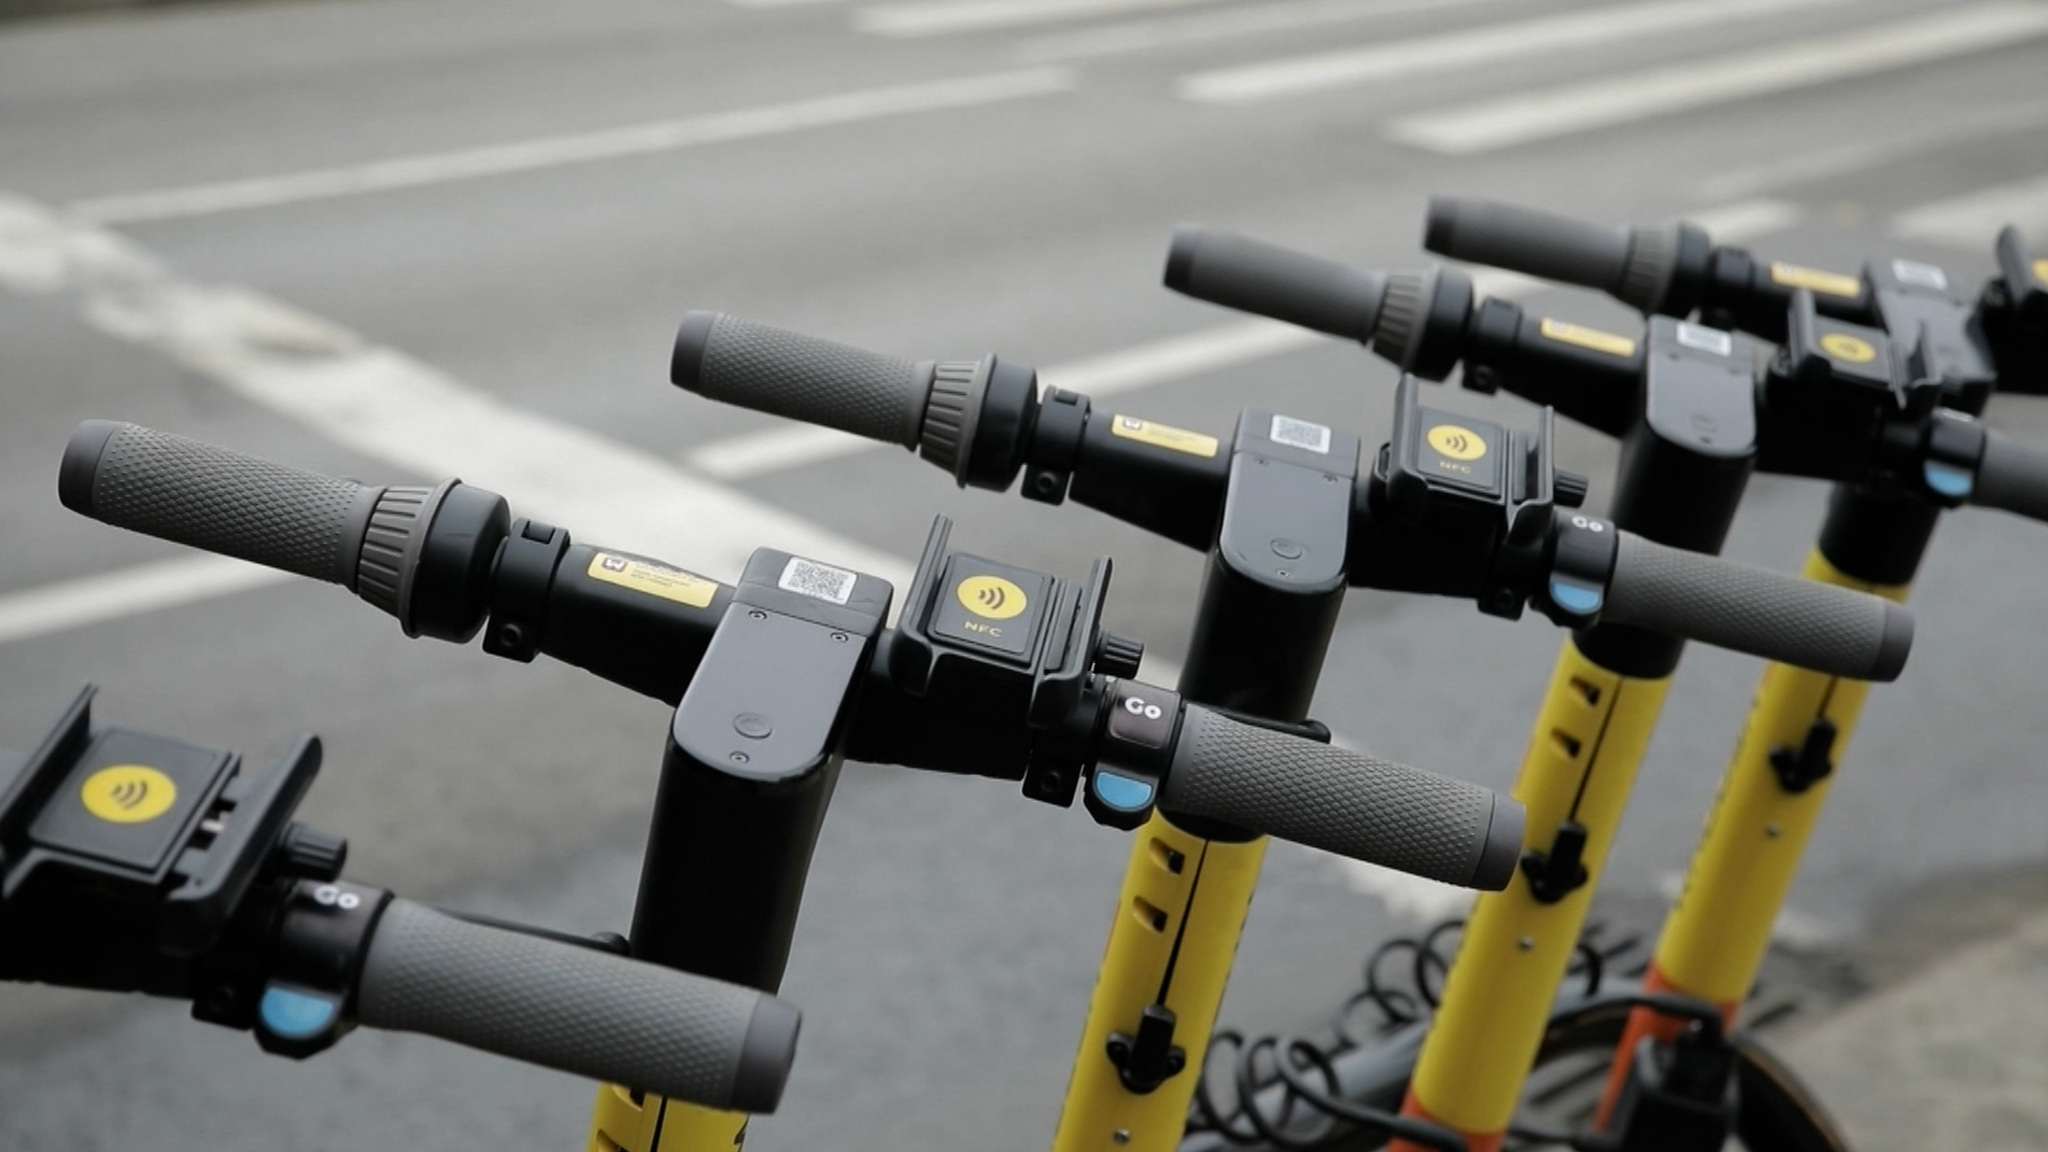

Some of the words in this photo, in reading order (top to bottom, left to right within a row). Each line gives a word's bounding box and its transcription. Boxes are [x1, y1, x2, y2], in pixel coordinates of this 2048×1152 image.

[1571, 515, 1604, 533] Go
[963, 621, 1002, 638] NFC
[1124, 696, 1162, 719] Go
[314, 885, 360, 910] Go
